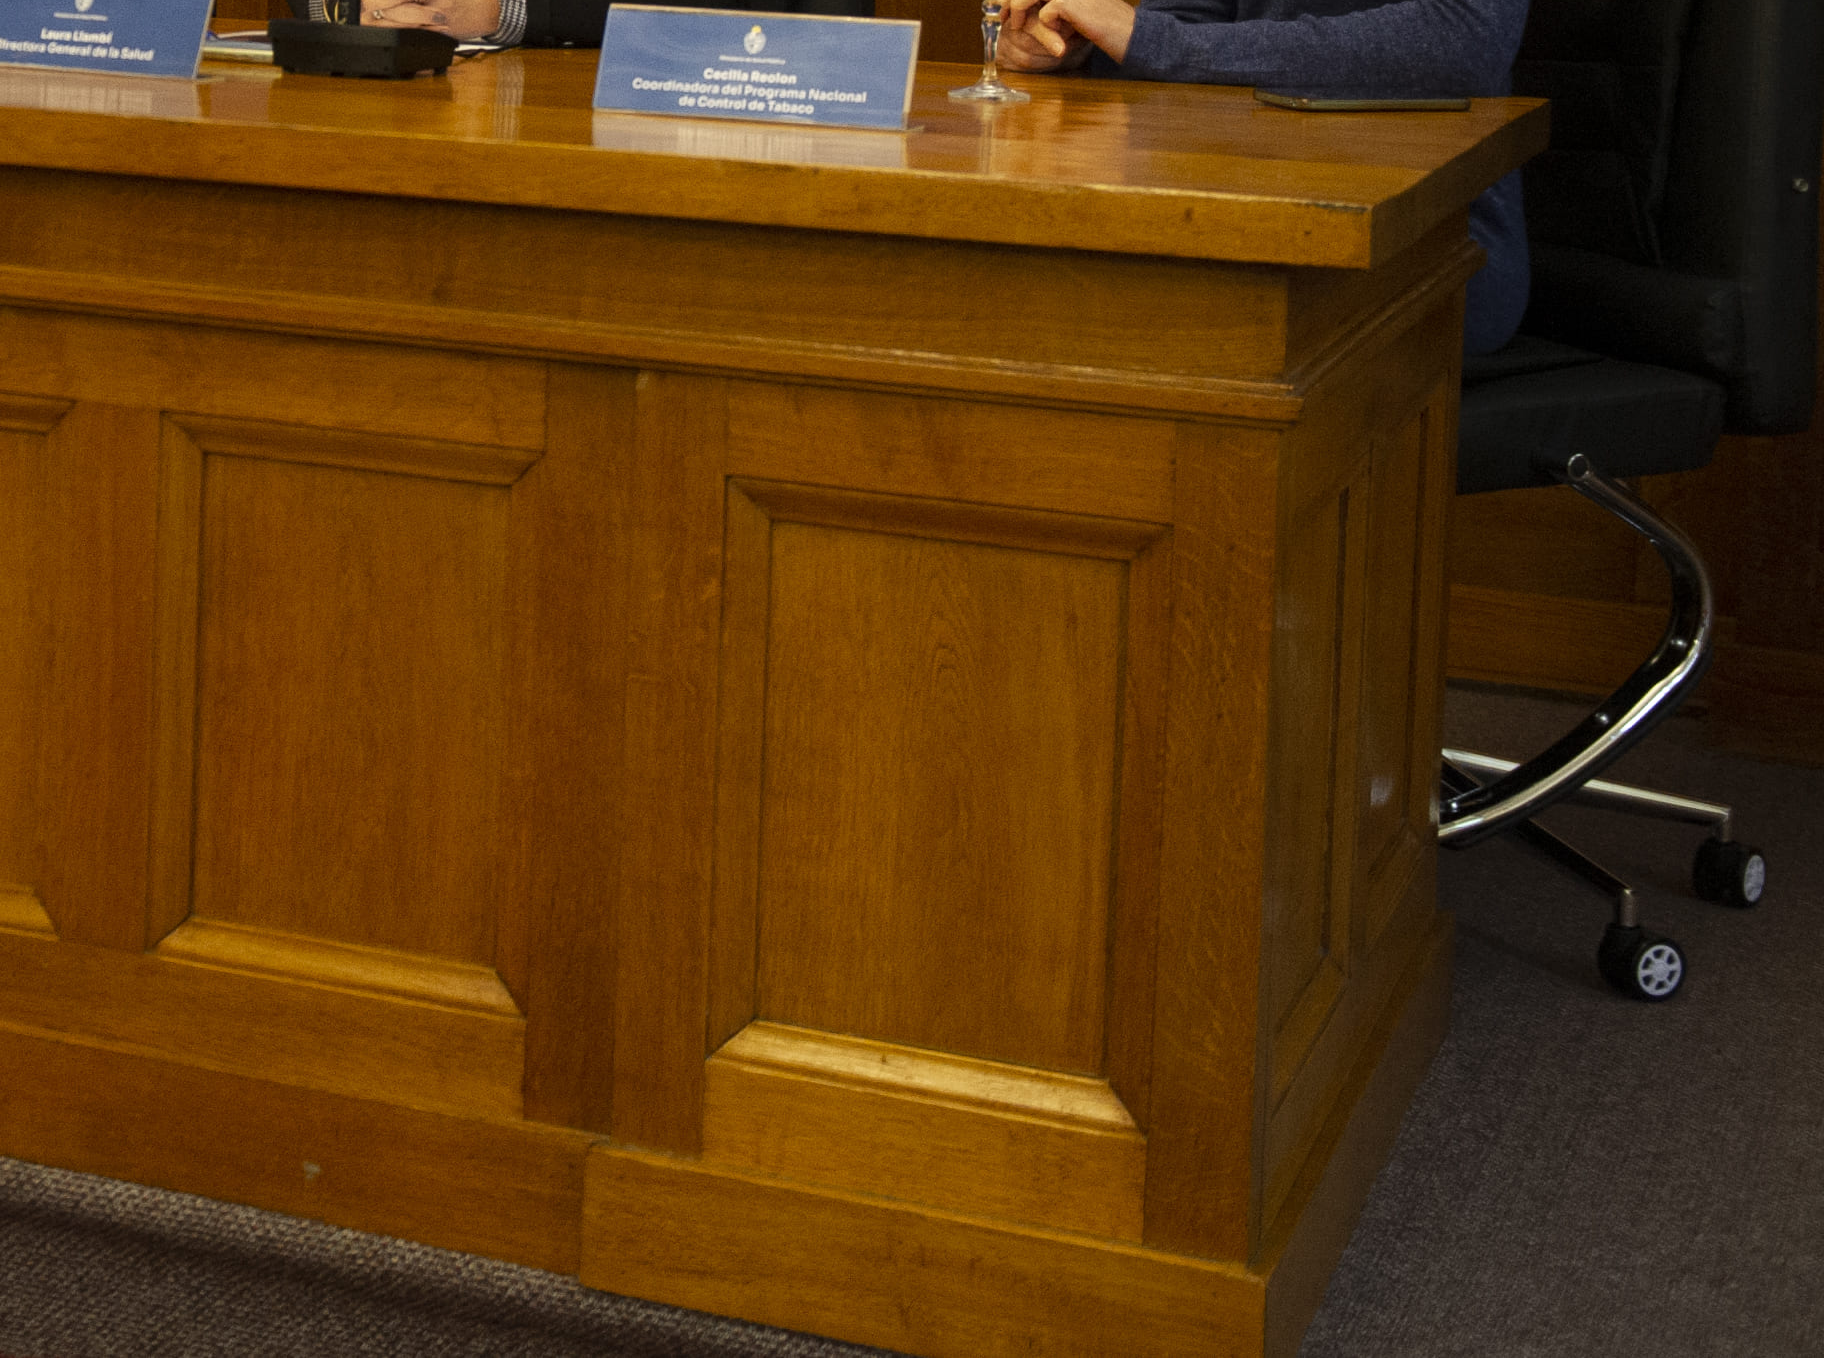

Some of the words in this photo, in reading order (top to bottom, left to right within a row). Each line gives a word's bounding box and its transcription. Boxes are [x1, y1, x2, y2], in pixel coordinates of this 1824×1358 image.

[40, 27, 72, 41] Laura
[47, 41, 91, 57] General
[92, 46, 107, 57] de
[108, 46, 120, 58] la
[121, 48, 155, 61] Salud
[703, 67, 750, 84] Cecilia
[751, 70, 797, 85] Reolon
[632, 77, 720, 97] Coordinadora
[721, 82, 743, 97] del
[744, 84, 806, 102] Programa
[809, 87, 867, 104] Nacional
[678, 94, 695, 108] de
[696, 96, 746, 111] Control
[747, 98, 766, 112] de
[768, 100, 815, 115] Tabaco
